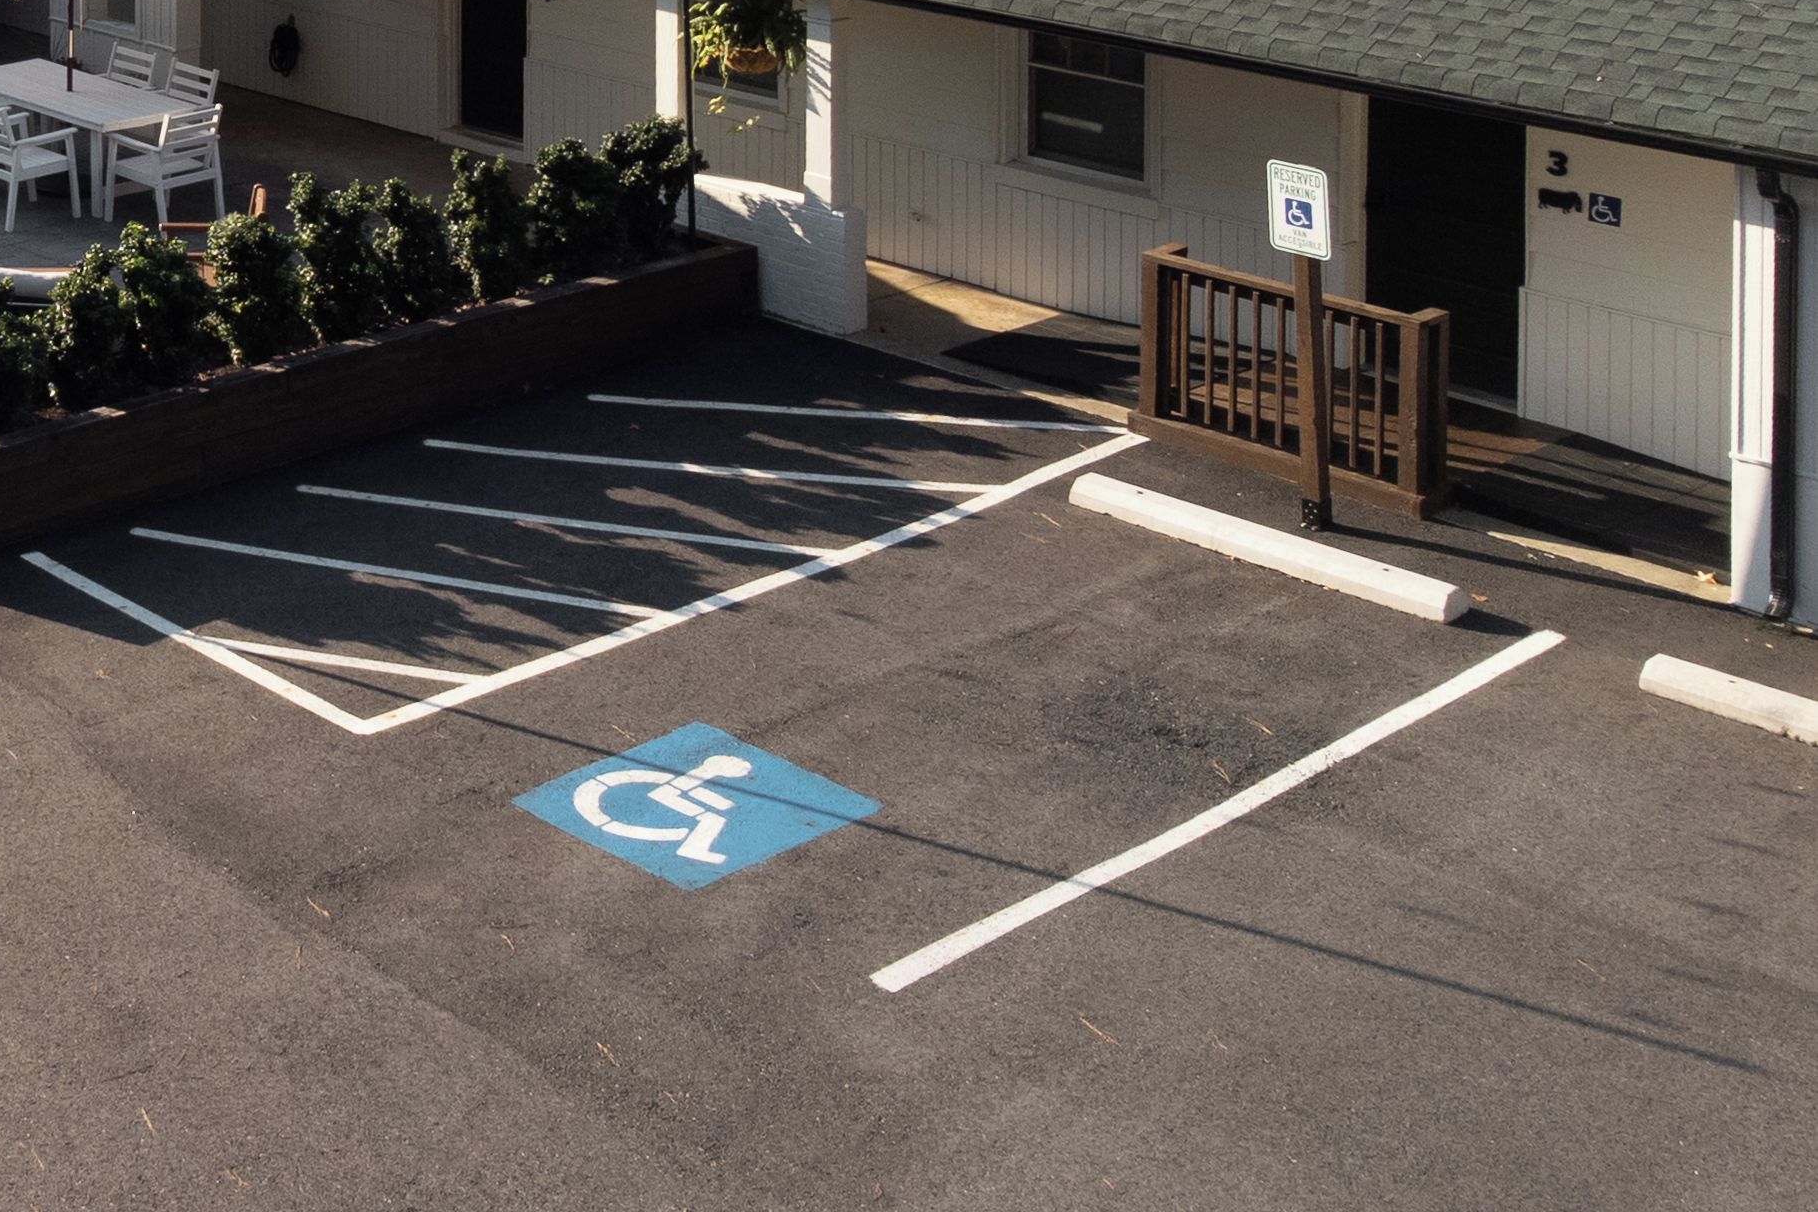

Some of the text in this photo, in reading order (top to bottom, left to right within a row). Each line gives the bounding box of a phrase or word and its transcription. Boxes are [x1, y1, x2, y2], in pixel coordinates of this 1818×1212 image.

[1546, 150, 1568, 176] 3
[1273, 167, 1321, 188] RESERVED
[1279, 183, 1317, 201] PARKING
[1292, 229, 1307, 238] VAN
